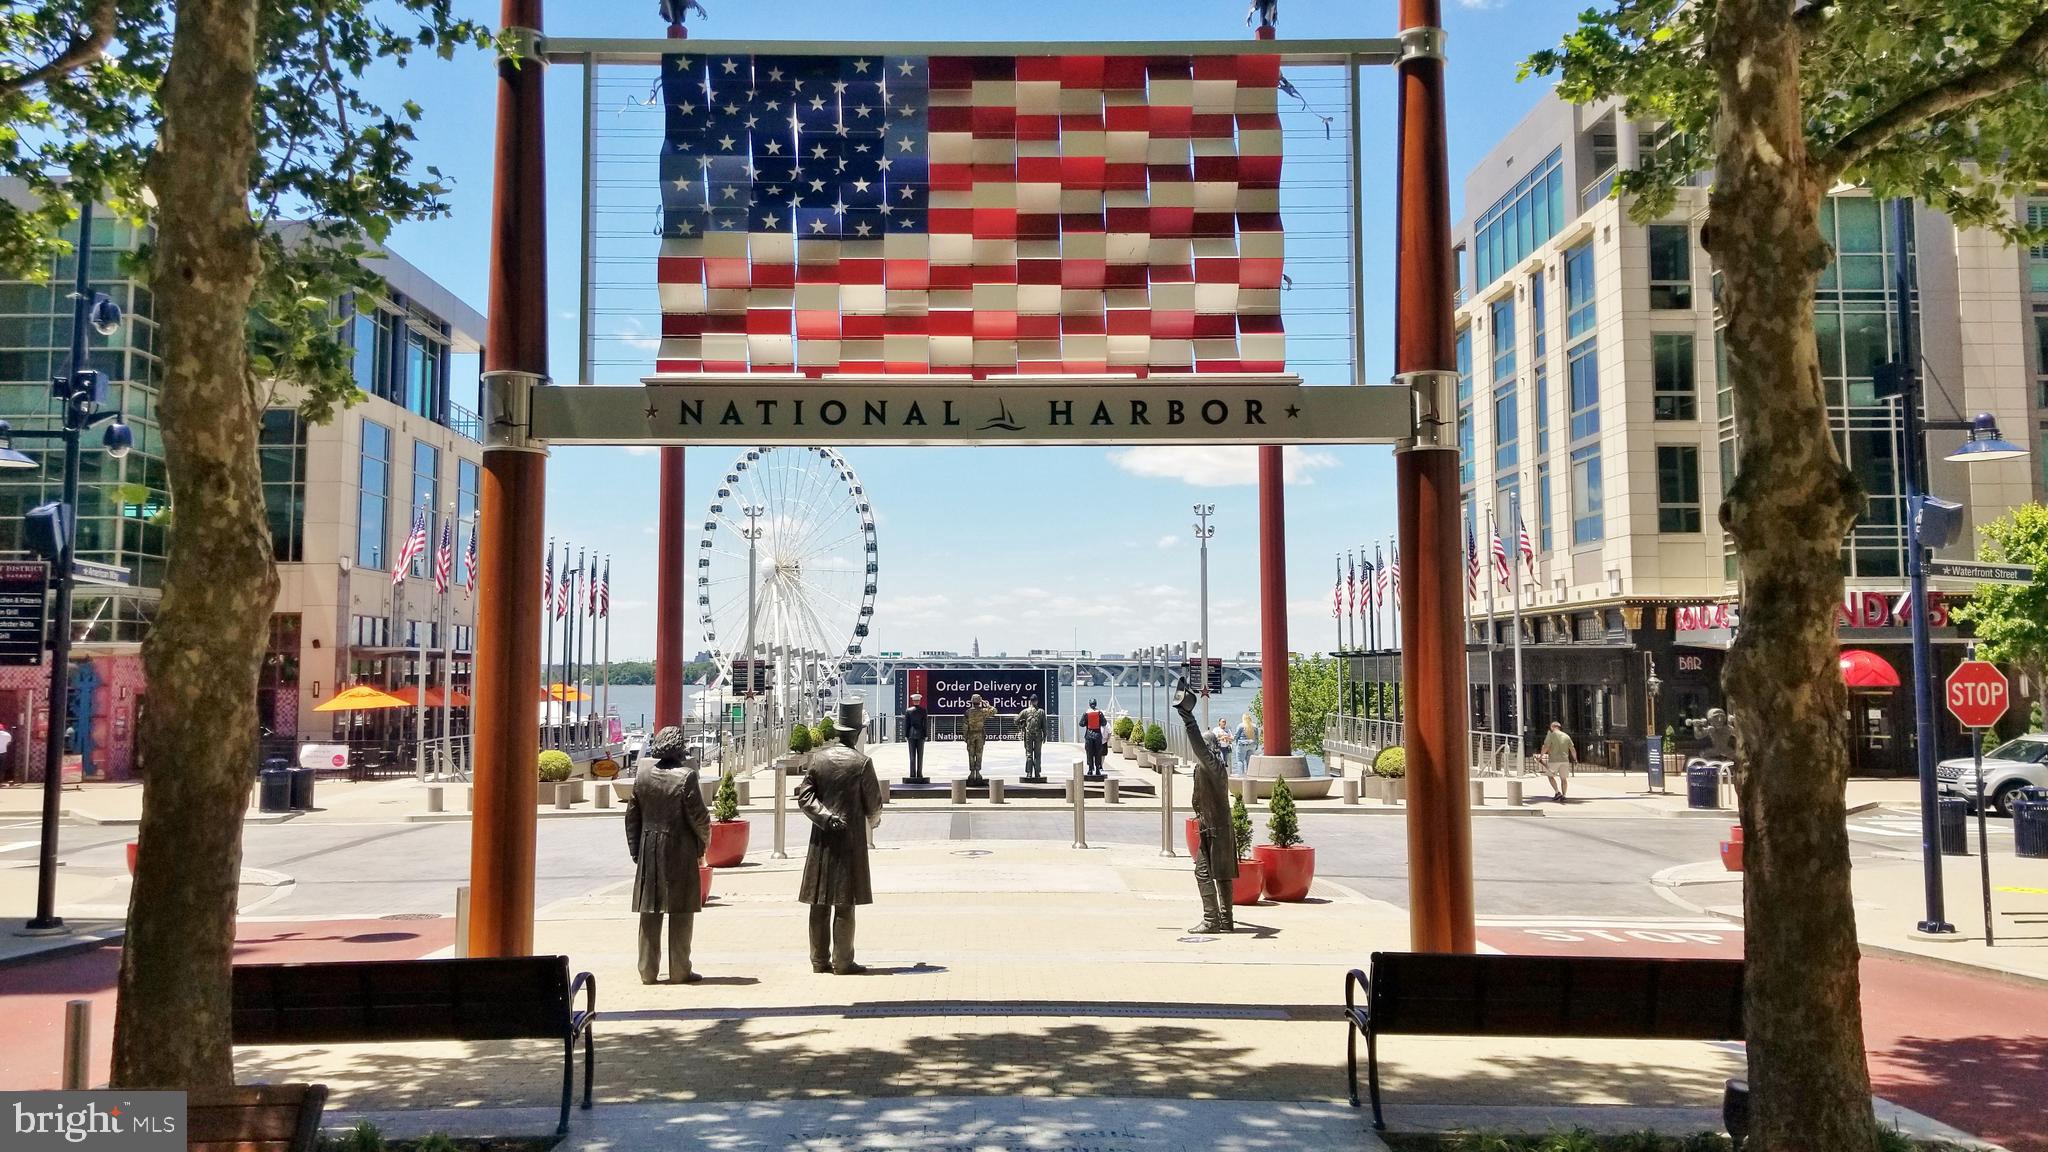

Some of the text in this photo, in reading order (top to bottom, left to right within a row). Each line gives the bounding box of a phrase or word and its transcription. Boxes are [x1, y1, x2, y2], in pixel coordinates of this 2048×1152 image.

[679, 399, 1267, 426] NATIONAL HARBOR
[1952, 566, 2018, 580] Waterfront Street
[1675, 603, 1730, 631] BOND 45
[1840, 591, 1889, 628] ND
[1679, 656, 1702, 670] BAR
[936, 680, 1037, 693] Order Delivery or
[1951, 681, 2004, 706] STOP
[1523, 929, 1723, 945] STOP
